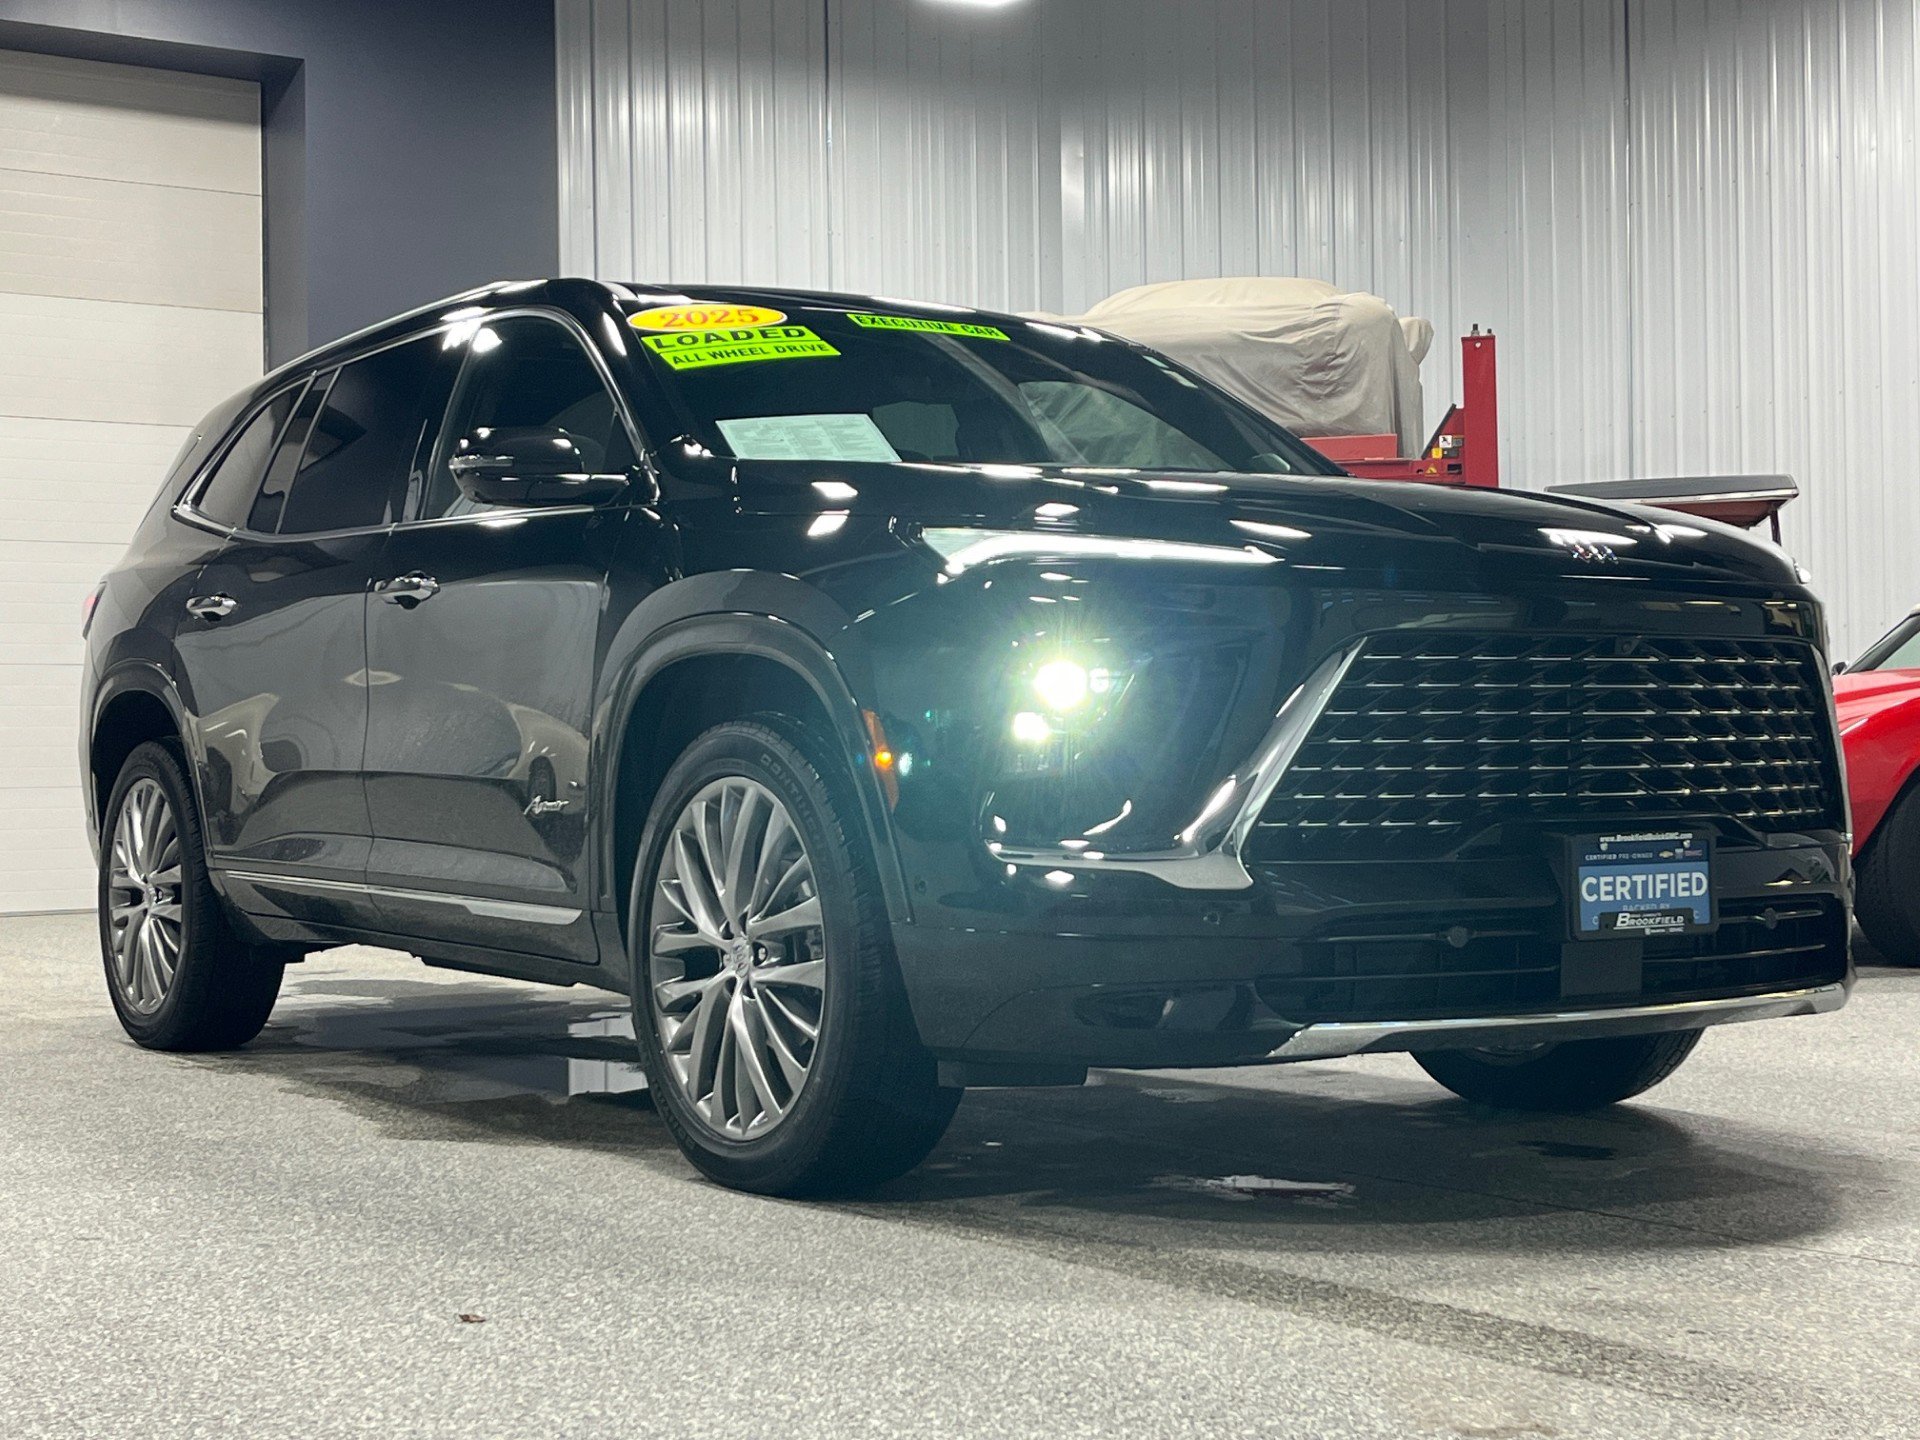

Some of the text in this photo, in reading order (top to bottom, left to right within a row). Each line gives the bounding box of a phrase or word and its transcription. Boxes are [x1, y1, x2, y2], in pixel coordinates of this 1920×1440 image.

[659, 308, 760, 328] 2025
[855, 314, 1001, 338] EXECUTIVE CAR
[652, 326, 807, 350] LOADED
[672, 343, 830, 366] ALL WHEEL DRIVE
[1581, 872, 1708, 902] CERTIFIED
